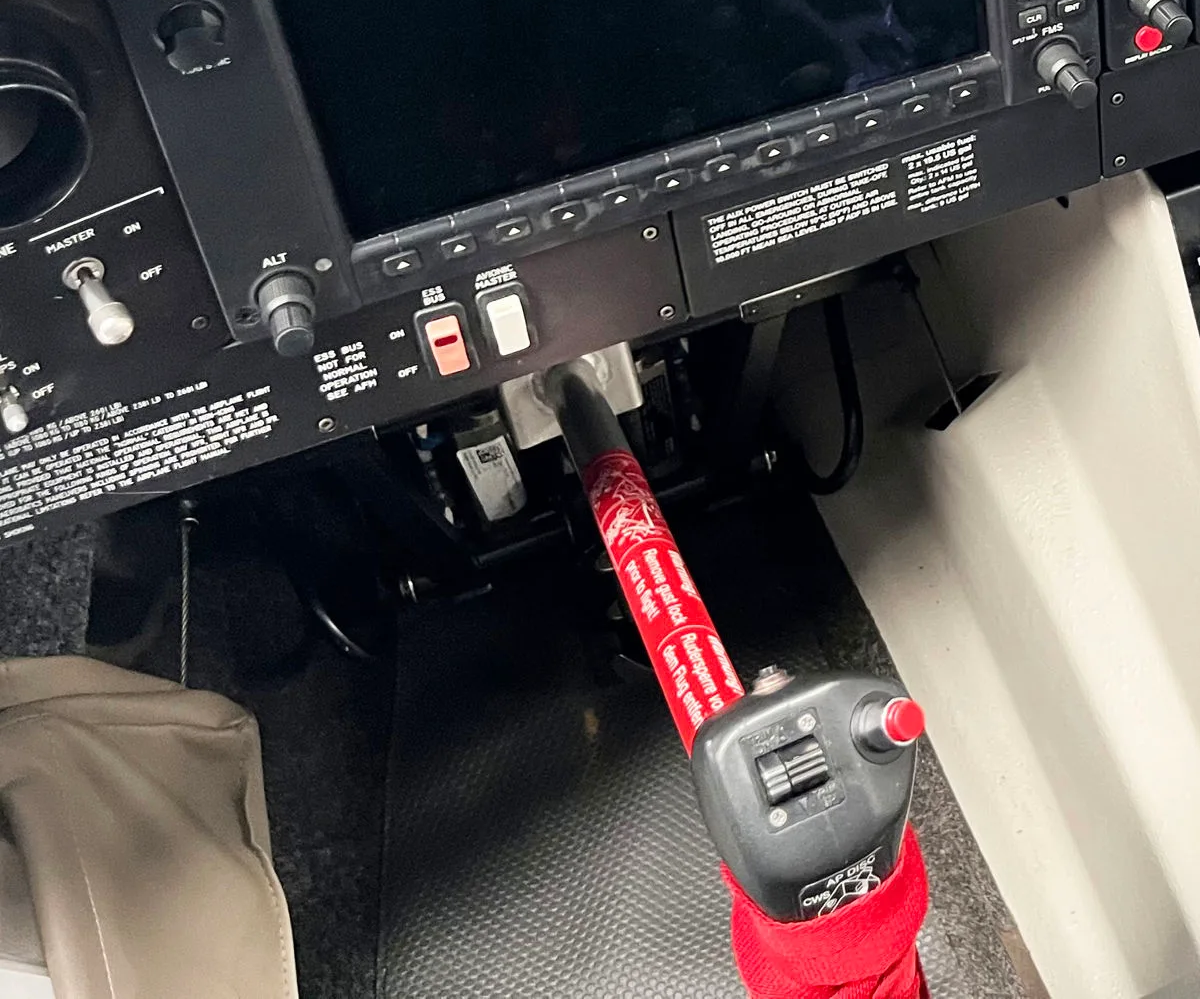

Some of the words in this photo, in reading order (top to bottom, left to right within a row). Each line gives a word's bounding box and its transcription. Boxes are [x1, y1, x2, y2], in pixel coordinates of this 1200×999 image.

[1042, 23, 1063, 36] FMS
[707, 215, 725, 225] THE
[726, 209, 744, 220] AUX
[744, 199, 776, 214] POWER
[777, 189, 808, 203] SWITCH
[810, 180, 833, 194] MUST
[834, 176, 846, 186] BE
[847, 163, 889, 181] SWITCHED
[123, 222, 141, 235] ON
[712, 229, 759, 249] OPERATING
[818, 206, 829, 214] AT
[829, 194, 864, 210] OUTSIDE
[865, 189, 879, 199] AIR
[45, 228, 96, 254] MASTER
[262, 252, 287, 269] ALT
[140, 264, 163, 281] OFF
[475, 263, 514, 282] AVIONIC
[475, 270, 518, 291] MASTER
[421, 285, 443, 298] ESS
[423, 292, 446, 306] BUS
[389, 329, 405, 341] ON
[313, 349, 336, 363] ESS
[340, 341, 363, 355] BUS
[317, 359, 339, 373] NOT
[345, 351, 366, 364] FOR
[22, 362, 40, 375] ON
[322, 361, 368, 382] NORMAL
[398, 365, 418, 378] OFF
[32, 382, 54, 399] OFF
[319, 368, 378, 393] OPERATION
[326, 388, 348, 402] SEE
[354, 379, 377, 393] AFM
[170, 412, 190, 422] WITH
[192, 406, 207, 416] THE
[246, 385, 271, 399] FLIGHT
[625, 559, 641, 584] prior
[635, 579, 645, 594] to
[643, 548, 666, 584] Remove
[655, 583, 679, 605] gust
[668, 604, 688, 626] lock
[662, 645, 679, 672] dem
[672, 665, 690, 698] Flug
[681, 633, 717, 695] Rudersperre
[709, 694, 724, 710] vo
[826, 873, 843, 888] AP
[802, 890, 831, 907] CWS
